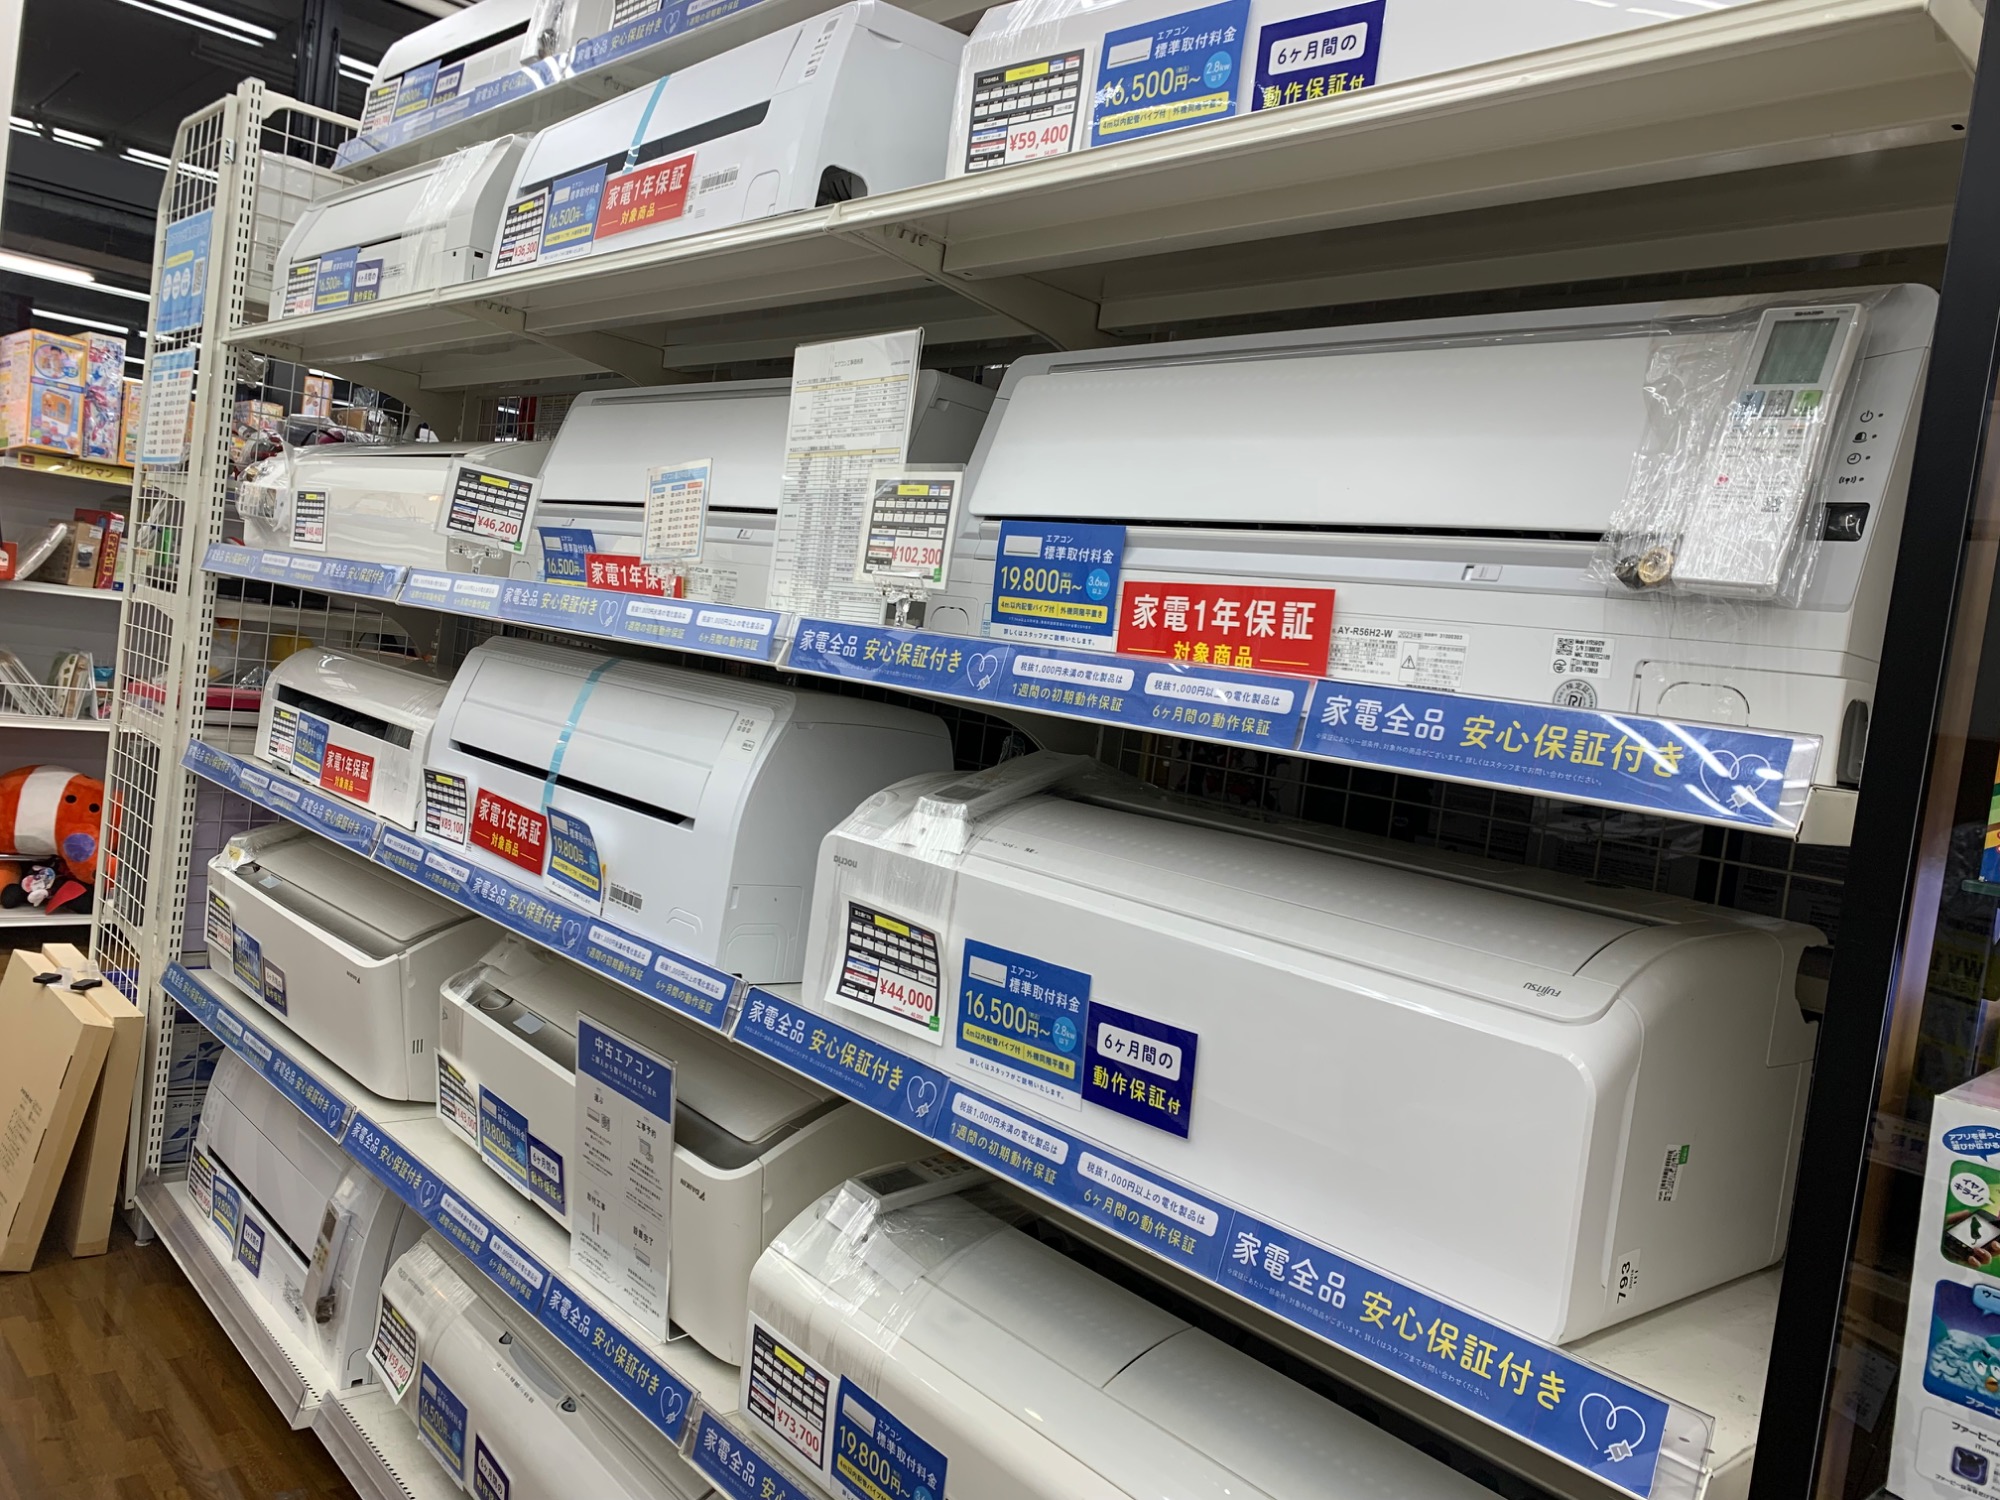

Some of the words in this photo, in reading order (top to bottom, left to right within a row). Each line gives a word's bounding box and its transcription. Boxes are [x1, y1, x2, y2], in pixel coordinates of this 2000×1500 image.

[611, 17, 662, 51] 安心保証付き
[1154, 26, 1237, 59] 標準取付料金
[1157, 26, 1189, 41] エアコン
[1276, 33, 1358, 66] 6ヶ月間の
[1210, 74, 1223, 82] 以下
[1262, 74, 1366, 110] 動作保証付
[1010, 124, 1069, 151] ¥59,400
[605, 163, 687, 211] 家電1年保証
[620, 202, 655, 226] 対象商品
[514, 241, 538, 258] ¥36,300
[477, 515, 518, 536] ¥46,200
[1046, 535, 1074, 544] エアコン
[891, 546, 943, 566] ¥102,300
[1044, 545, 1114, 564] 標準取付料金
[503, 587, 538, 608] 家電全品
[540, 591, 598, 616] 安心保証付き
[1131, 593, 1318, 641] 家電1年保証
[1337, 626, 1393, 638] AY-R56H2-W
[798, 628, 859, 659] 家電全品
[862, 637, 962, 674] 安心保証付き
[1173, 640, 1254, 669] 対象商品
[1020, 660, 1124, 686] 税抜1,000円未満の電化製品は
[1011, 681, 1124, 712] 1週間の初期動作保証
[1152, 705, 1273, 737] 6ヶ月間の動作保証
[1320, 695, 1446, 743] 家電全品
[1459, 714, 1687, 779] 安心保証付き
[326, 750, 370, 780] 家電1年保証
[478, 797, 544, 847] 家電1年保証
[490, 832, 519, 858] 対象商品
[833, 854, 858, 869] nocria
[471, 876, 507, 907] 家電全品
[507, 893, 563, 931] 安心保証付き
[1010, 964, 1039, 980] エアコン
[1523, 981, 1562, 998] FUJITSU
[879, 977, 934, 1013] ¥44,000
[1008, 975, 1081, 1014] 標準取付料金
[594, 1036, 655, 1079] 中古エアコン
[748, 1000, 806, 1044] 家電全品
[808, 1028, 904, 1091] 安心保証付き
[1103, 1033, 1174, 1070] 6ヶ月間の
[294, 1076, 331, 1113] 安心保証付き
[969, 1057, 1065, 1101] 詳しくはスタッフがご説明いたします。
[1093, 1065, 1182, 1116] 動作保証付
[959, 1099, 1059, 1156] 税抜1,000円未満の電化製品は
[350, 1121, 381, 1156] 家電全品
[378, 1144, 423, 1190] 安心保証付き
[949, 1120, 1058, 1187] 1週間の初期動作保証
[1086, 1160, 1206, 1227] 税抜1,000円以上の電化製品は
[1082, 1187, 1197, 1256] 6ヶ月間の動作保証
[1616, 1260, 1632, 1305] 793
[1231, 1230, 1347, 1310] 家電全品
[1359, 1290, 1567, 1411] 安心保証付き
[548, 1289, 591, 1338] 家電全品
[591, 1326, 660, 1396] 安心保証付き
[777, 1406, 820, 1453] ¥73,700
[878, 1419, 902, 1441] エアコン
[703, 1427, 756, 1489] 家電全品
[876, 1430, 938, 1491] 標準取付料金
